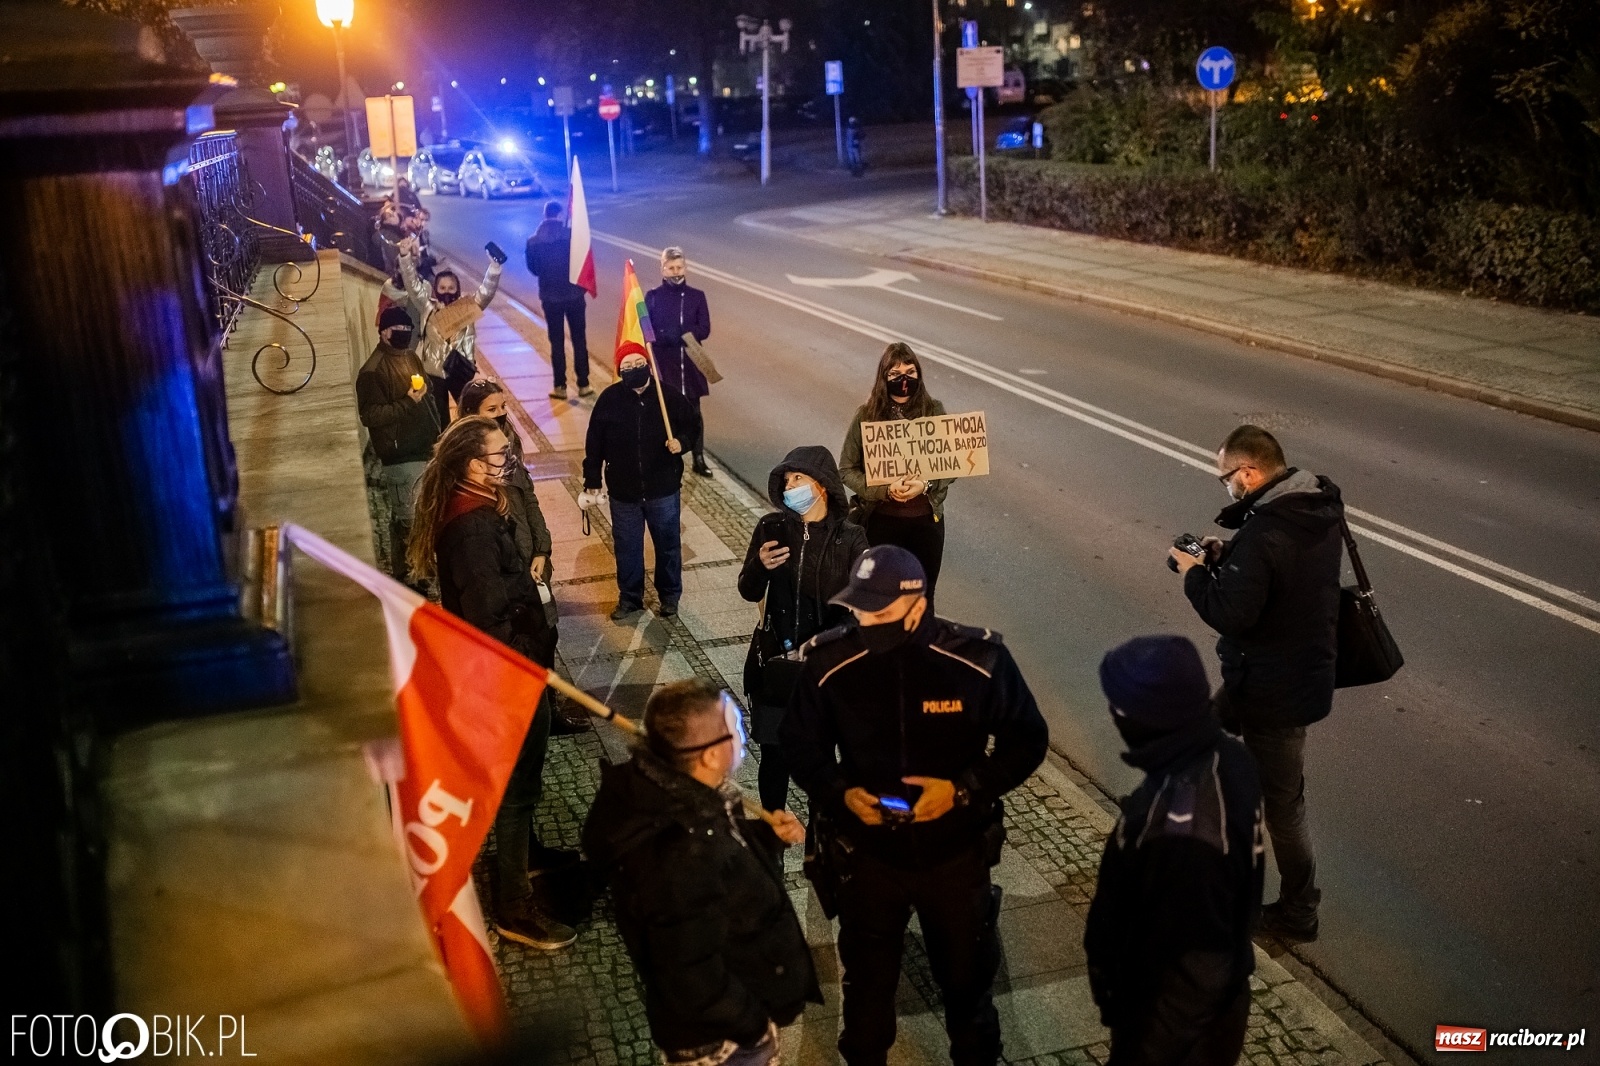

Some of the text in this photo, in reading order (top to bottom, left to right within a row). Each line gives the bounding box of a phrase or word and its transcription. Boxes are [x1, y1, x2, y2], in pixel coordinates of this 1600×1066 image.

[915, 421, 936, 437] TO
[941, 415, 985, 436] TWOJA
[907, 438, 952, 456] TWOJA
[954, 435, 987, 451] BARDZO
[867, 455, 961, 479] WIELKA WINA
[900, 579, 923, 590] POLICJA
[922, 700, 963, 713] POLICJA
